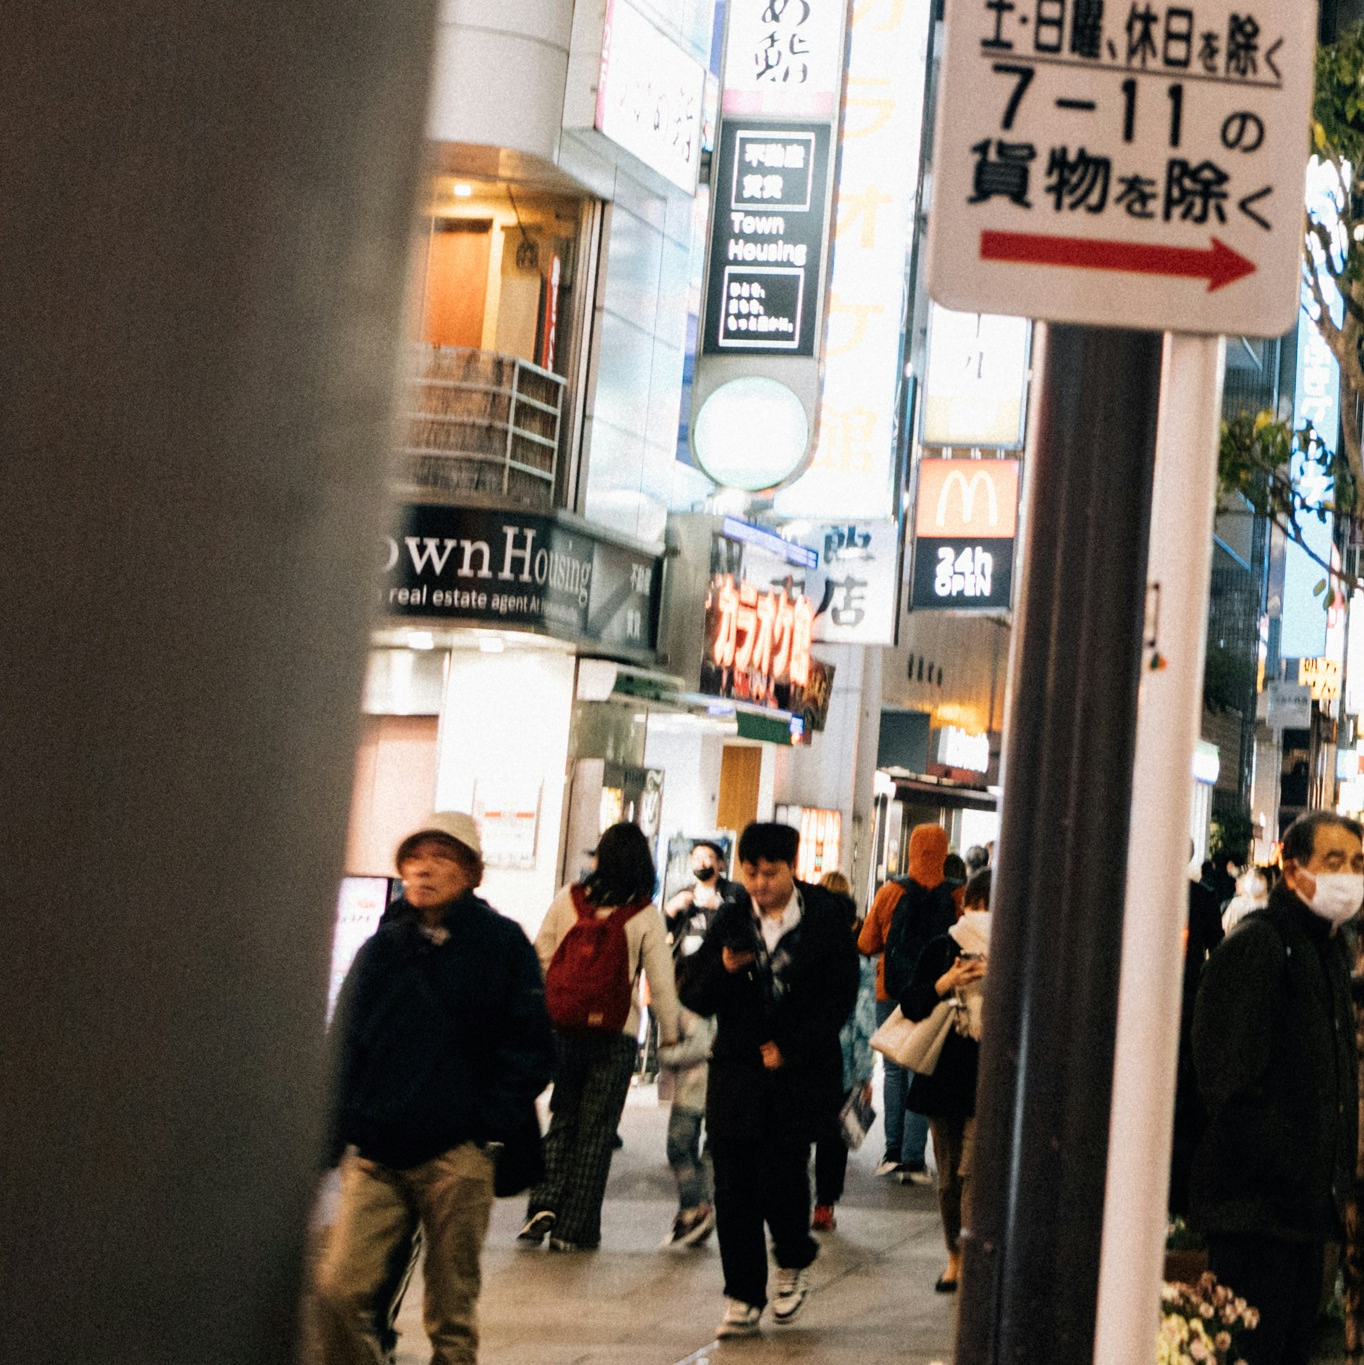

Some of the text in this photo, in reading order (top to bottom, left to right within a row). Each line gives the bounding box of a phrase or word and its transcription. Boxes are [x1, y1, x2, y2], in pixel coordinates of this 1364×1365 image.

[966, 138, 1274, 232] 貨物を除く
[730, 211, 785, 235] Town
[728, 238, 808, 267] Housing
[935, 546, 993, 576] 24h
[390, 584, 428, 606] real
[432, 587, 488, 610] estate
[491, 592, 530, 616] agent
[934, 574, 992, 597] OPEN
